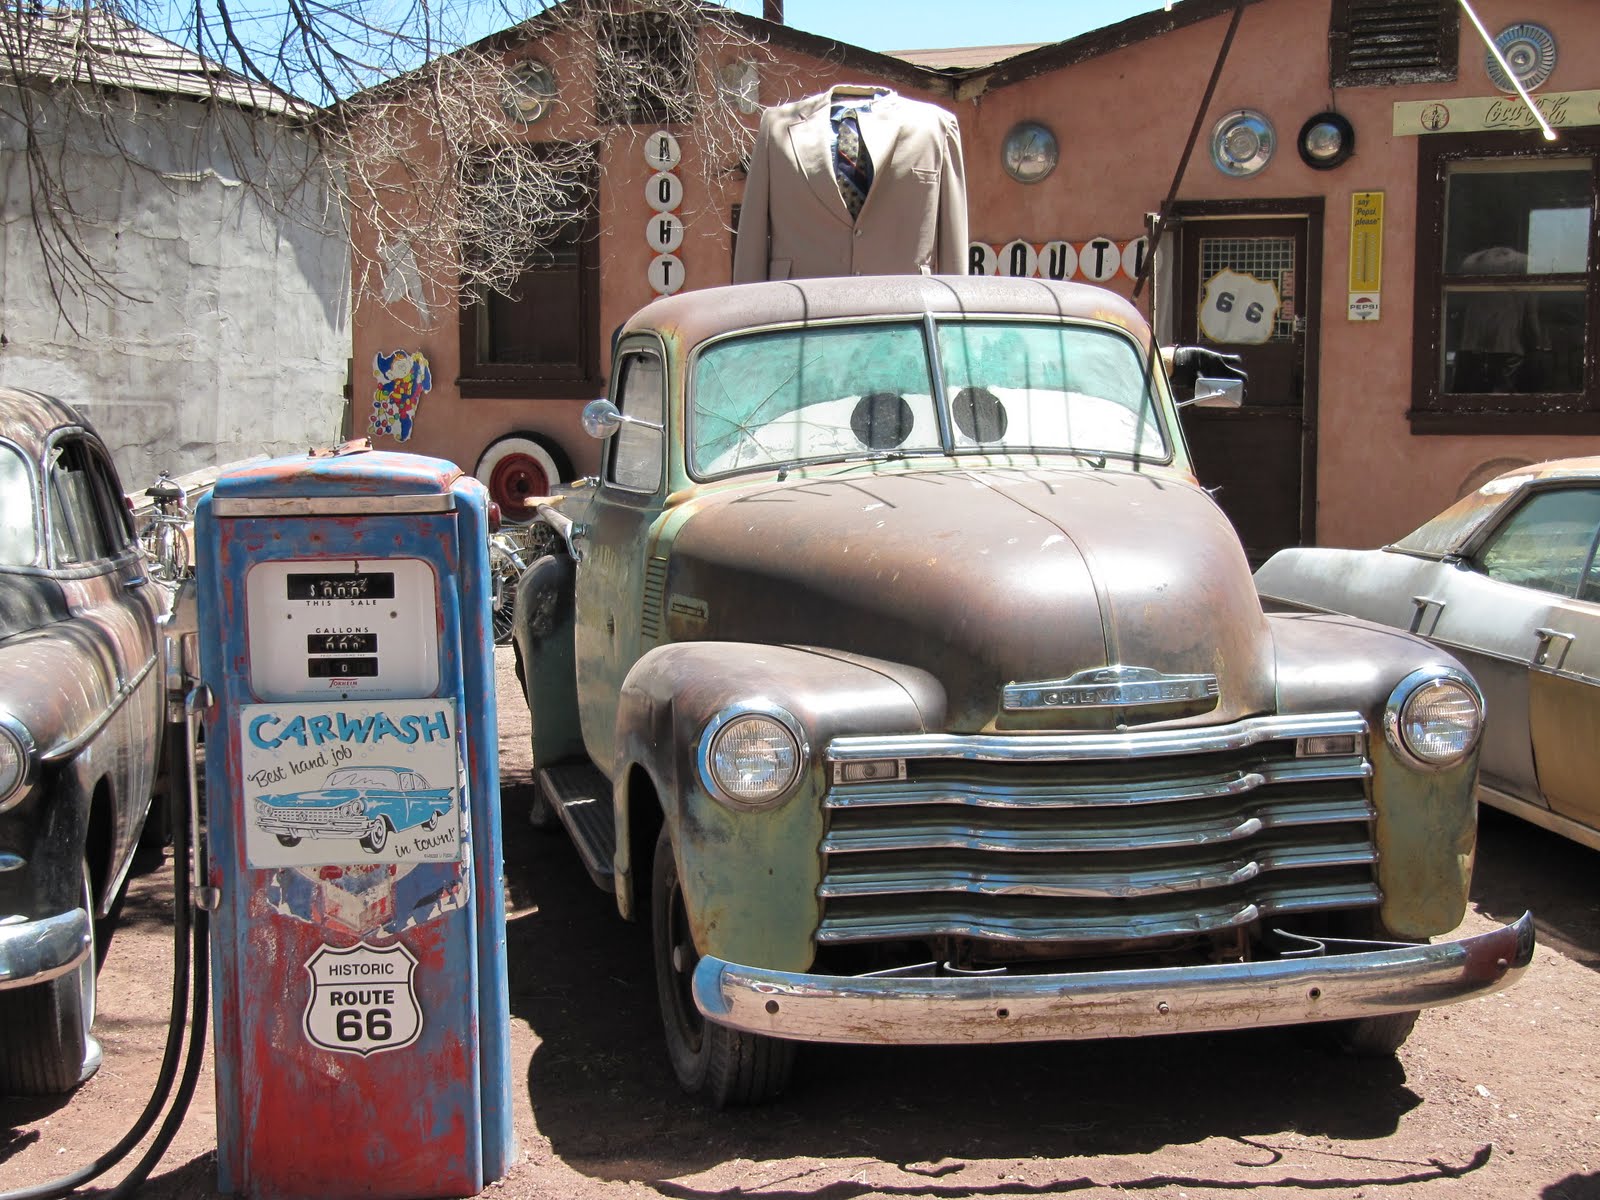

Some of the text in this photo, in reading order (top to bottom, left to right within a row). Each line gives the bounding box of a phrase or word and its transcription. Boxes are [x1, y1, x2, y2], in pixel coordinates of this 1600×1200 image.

[249, 711, 451, 749] CARWASH
[289, 753, 328, 775] hand
[332, 745, 353, 767] job
[394, 845, 411, 858] in
[329, 963, 394, 976] HISTORIC
[330, 990, 395, 1006] ROUTE
[336, 1008, 393, 1042] 66
